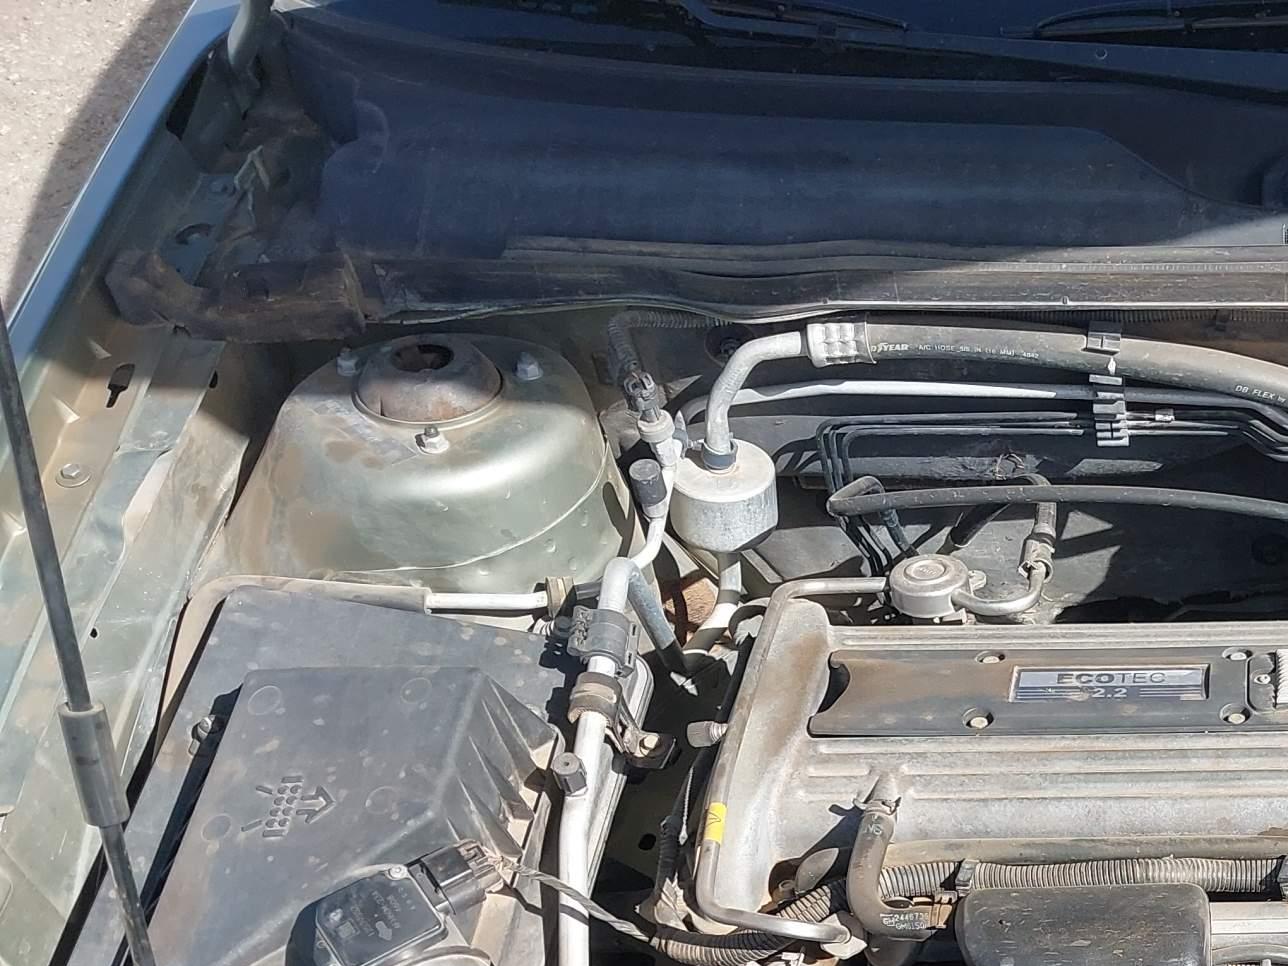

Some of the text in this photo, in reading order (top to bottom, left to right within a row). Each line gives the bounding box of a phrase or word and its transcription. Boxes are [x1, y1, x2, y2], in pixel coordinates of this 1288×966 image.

[1251, 388, 1275, 400] FLEX
[1057, 672, 1166, 684] ECOTEC
[1092, 688, 1127, 698] 2.2
